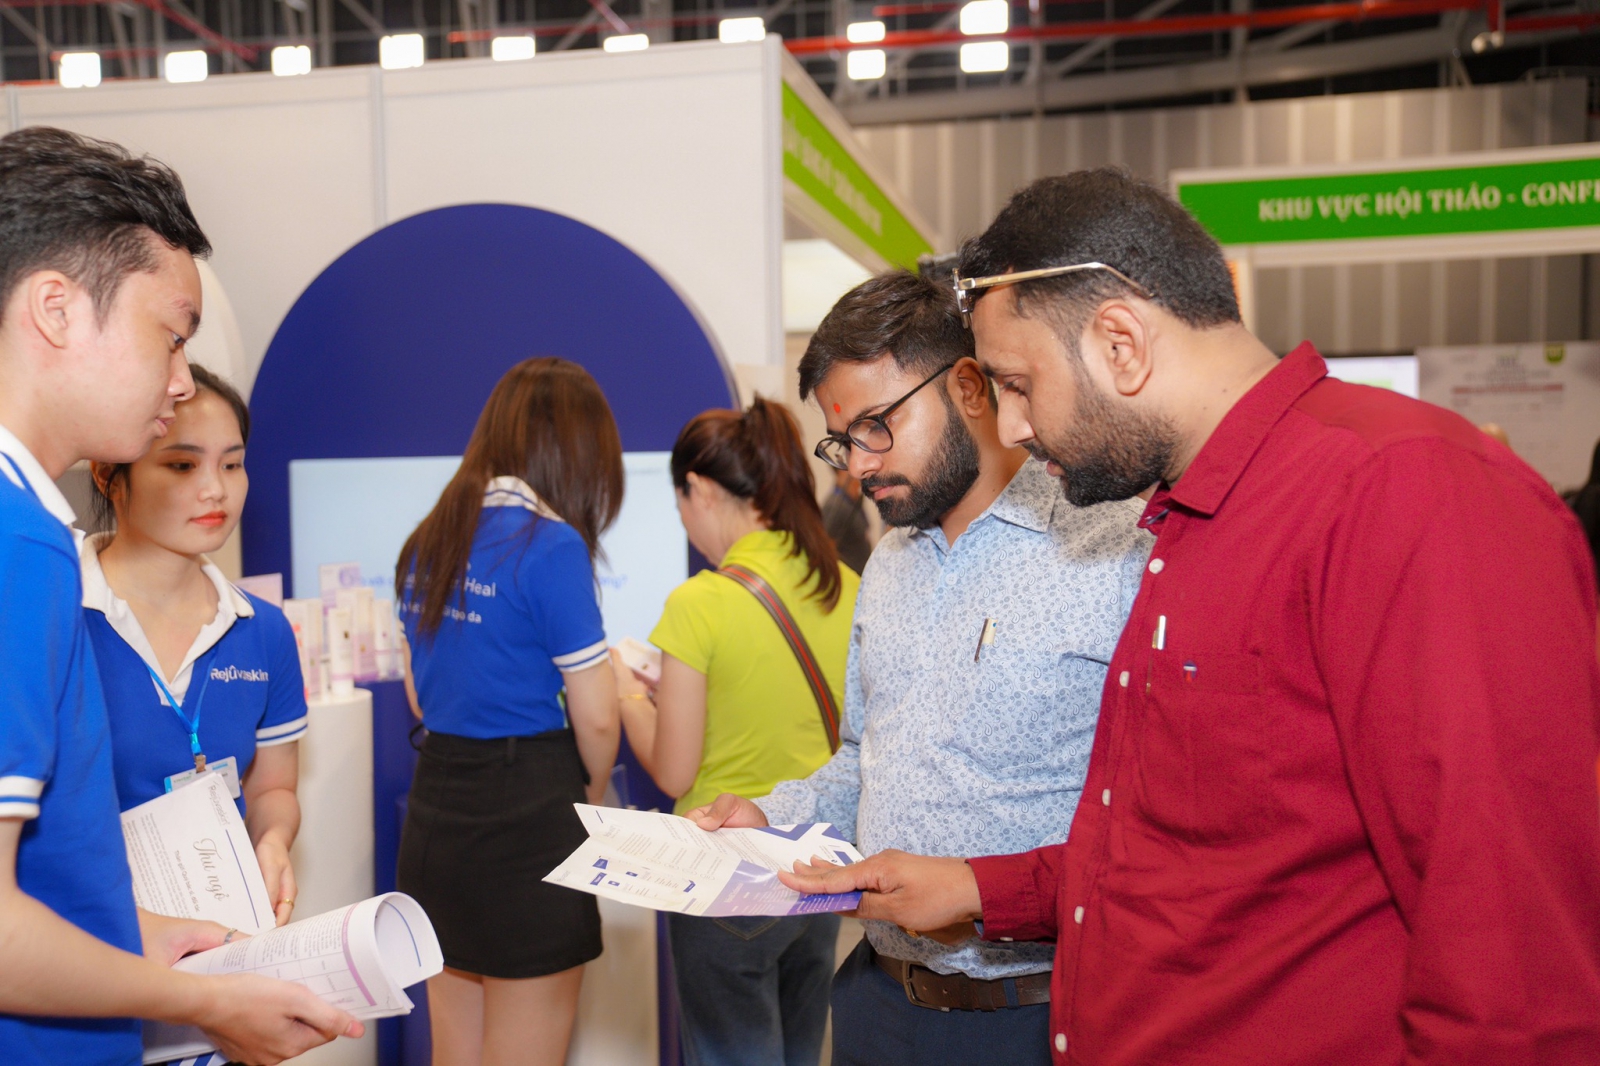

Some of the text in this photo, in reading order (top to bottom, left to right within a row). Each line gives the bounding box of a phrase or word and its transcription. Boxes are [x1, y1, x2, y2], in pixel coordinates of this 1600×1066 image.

[1258, 198, 1313, 221] KHU
[1316, 194, 1371, 222] VỰC
[1374, 186, 1422, 219] HỘI
[1426, 181, 1502, 213] THẢO
[464, 576, 496, 598] Heal
[467, 609, 482, 624] da
